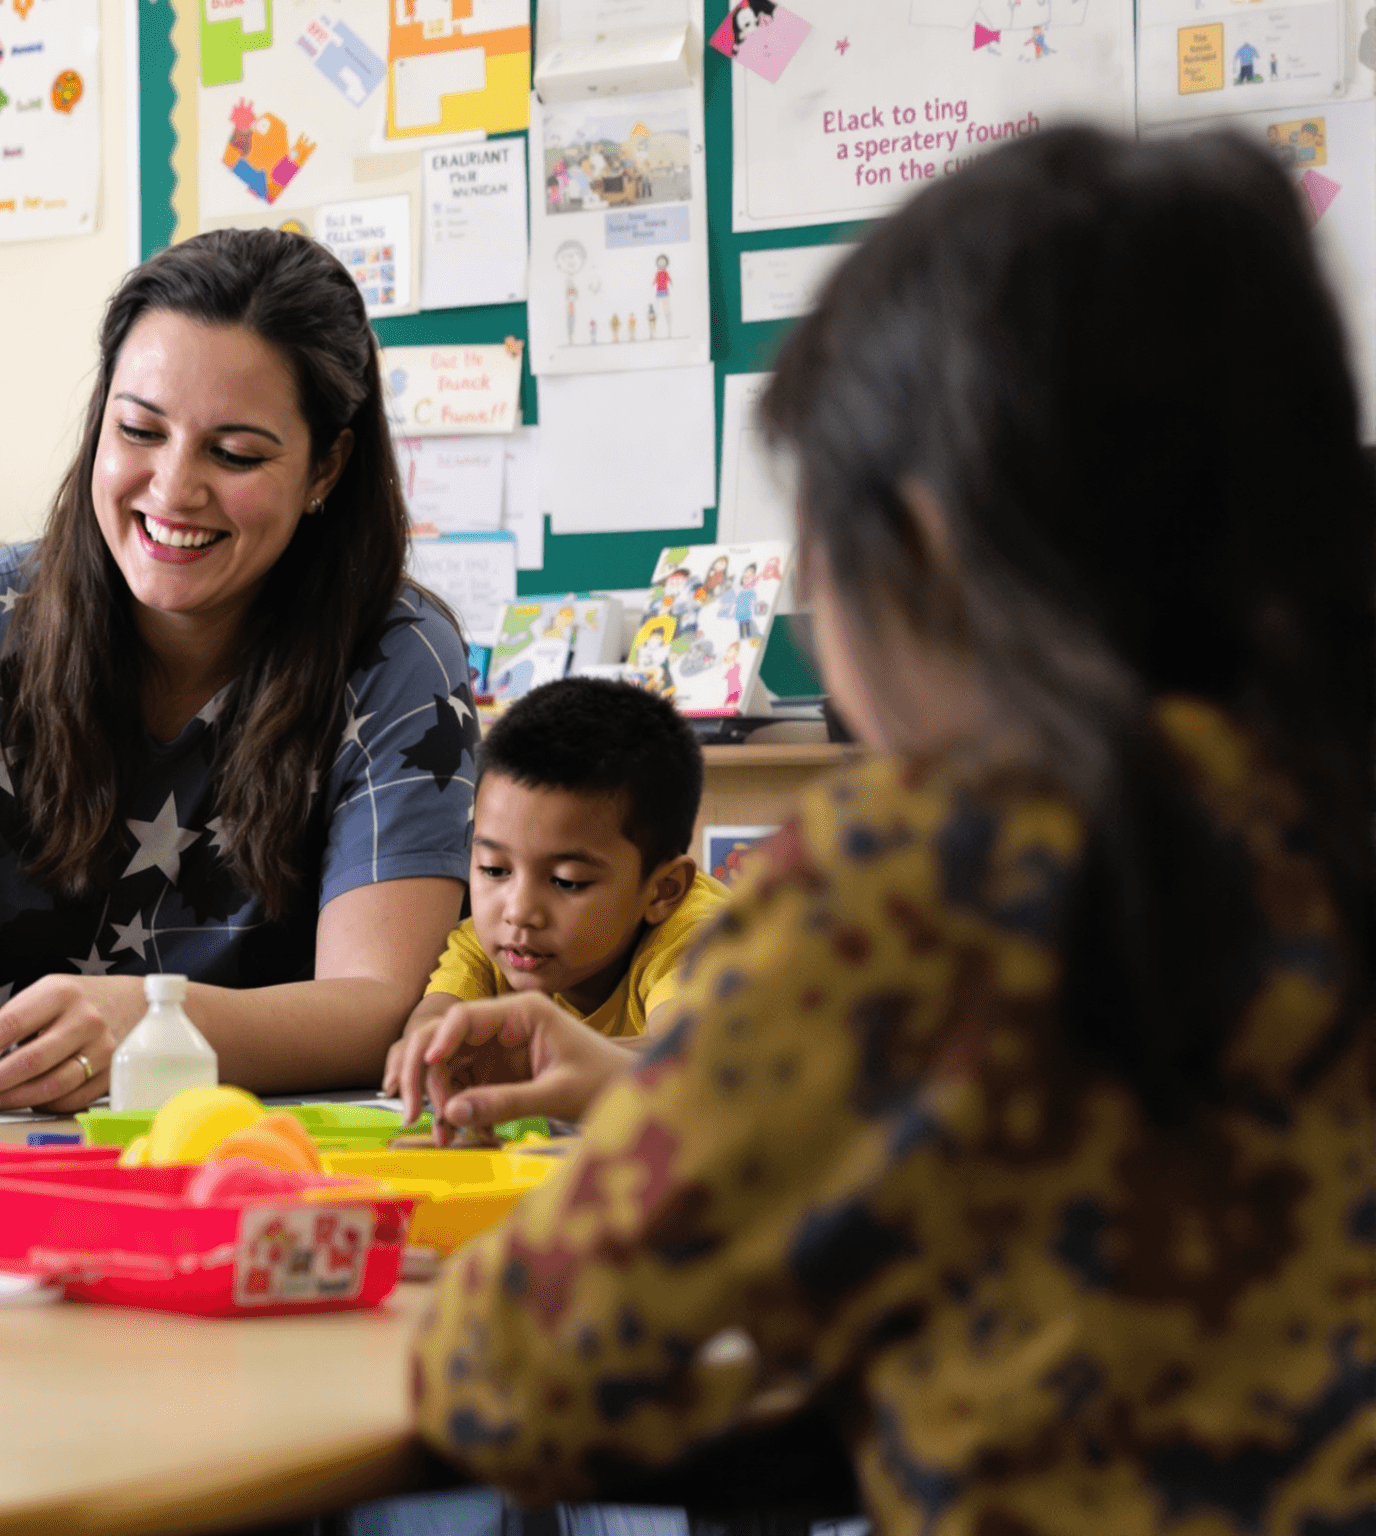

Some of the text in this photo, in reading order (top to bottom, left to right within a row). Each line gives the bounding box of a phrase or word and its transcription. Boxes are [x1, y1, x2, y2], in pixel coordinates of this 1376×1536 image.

[892, 105, 916, 126] to
[924, 98, 968, 123] ting
[837, 111, 1040, 163] a speratery founch
[855, 164, 892, 187] fon
[899, 158, 935, 182] the
